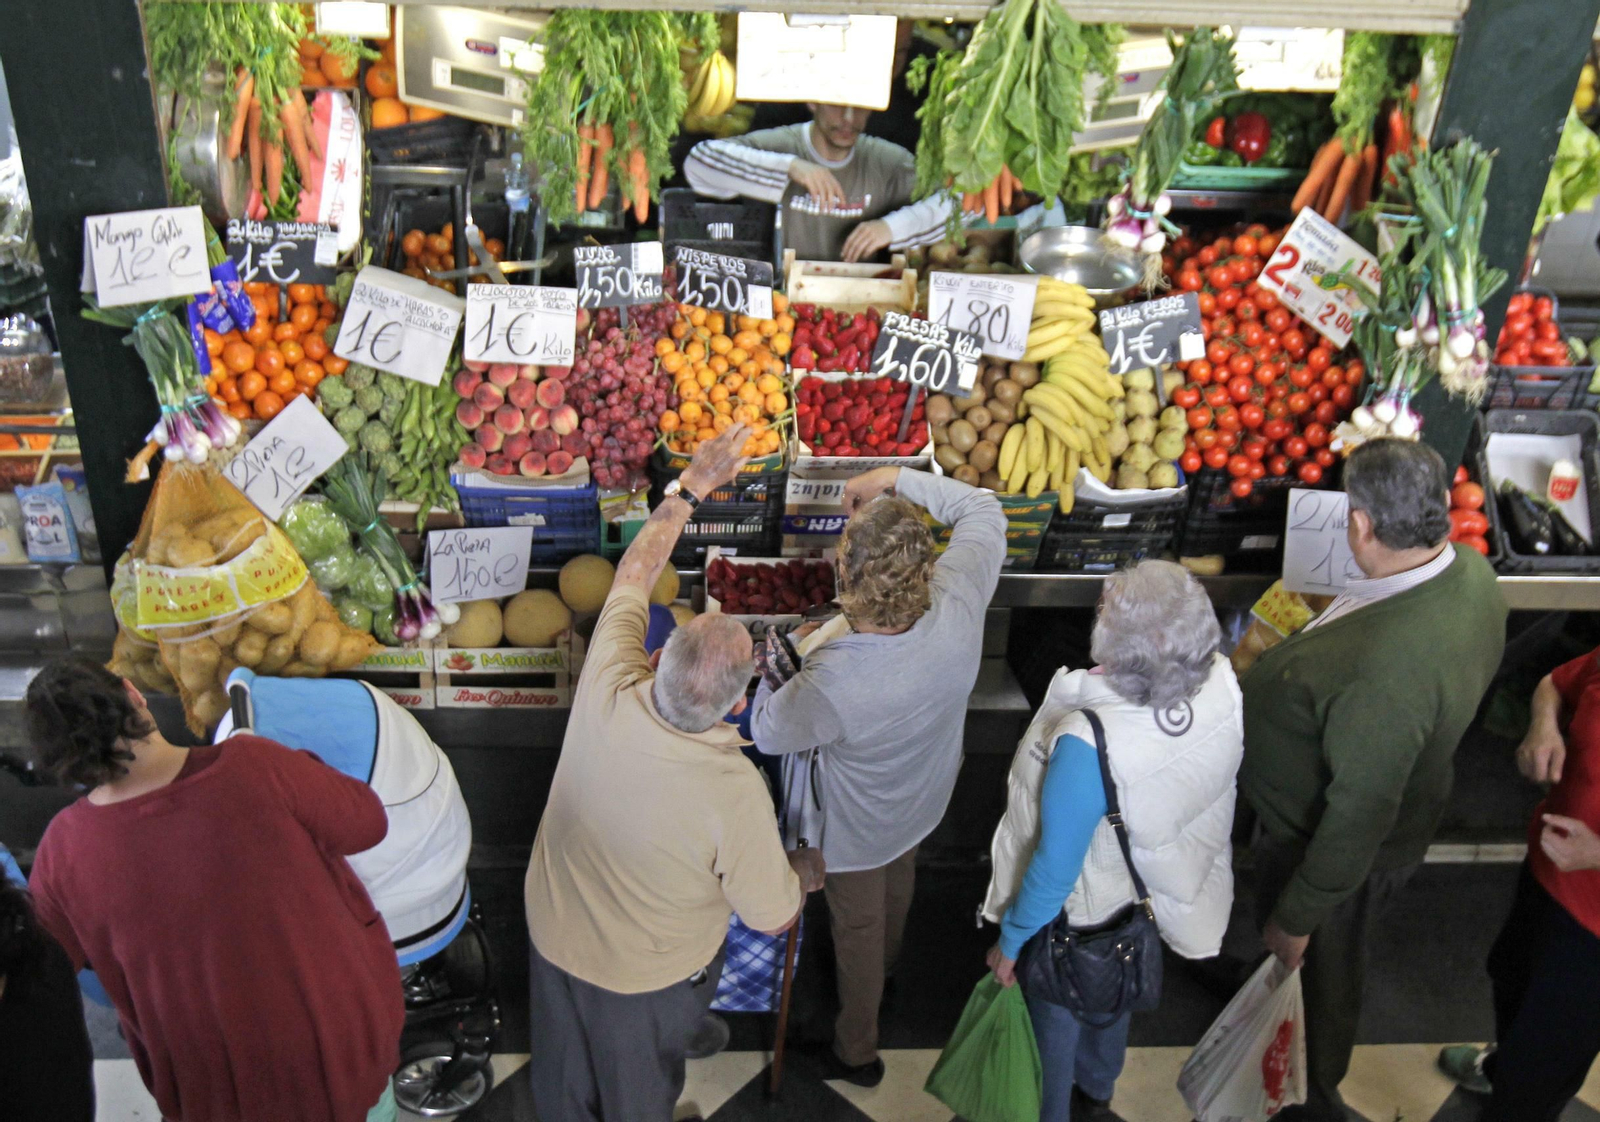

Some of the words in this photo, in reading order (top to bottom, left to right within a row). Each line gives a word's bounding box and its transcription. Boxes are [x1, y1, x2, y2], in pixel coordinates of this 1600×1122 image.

[236, 241, 301, 284] 1€
[1265, 243, 1300, 287] 2
[345, 310, 404, 364] 1€
[469, 302, 538, 358] 1€
[884, 311, 950, 339] FRESAS
[1110, 322, 1168, 375] 1€
[363, 651, 426, 666] anuel
[481, 651, 563, 667] Manuel
